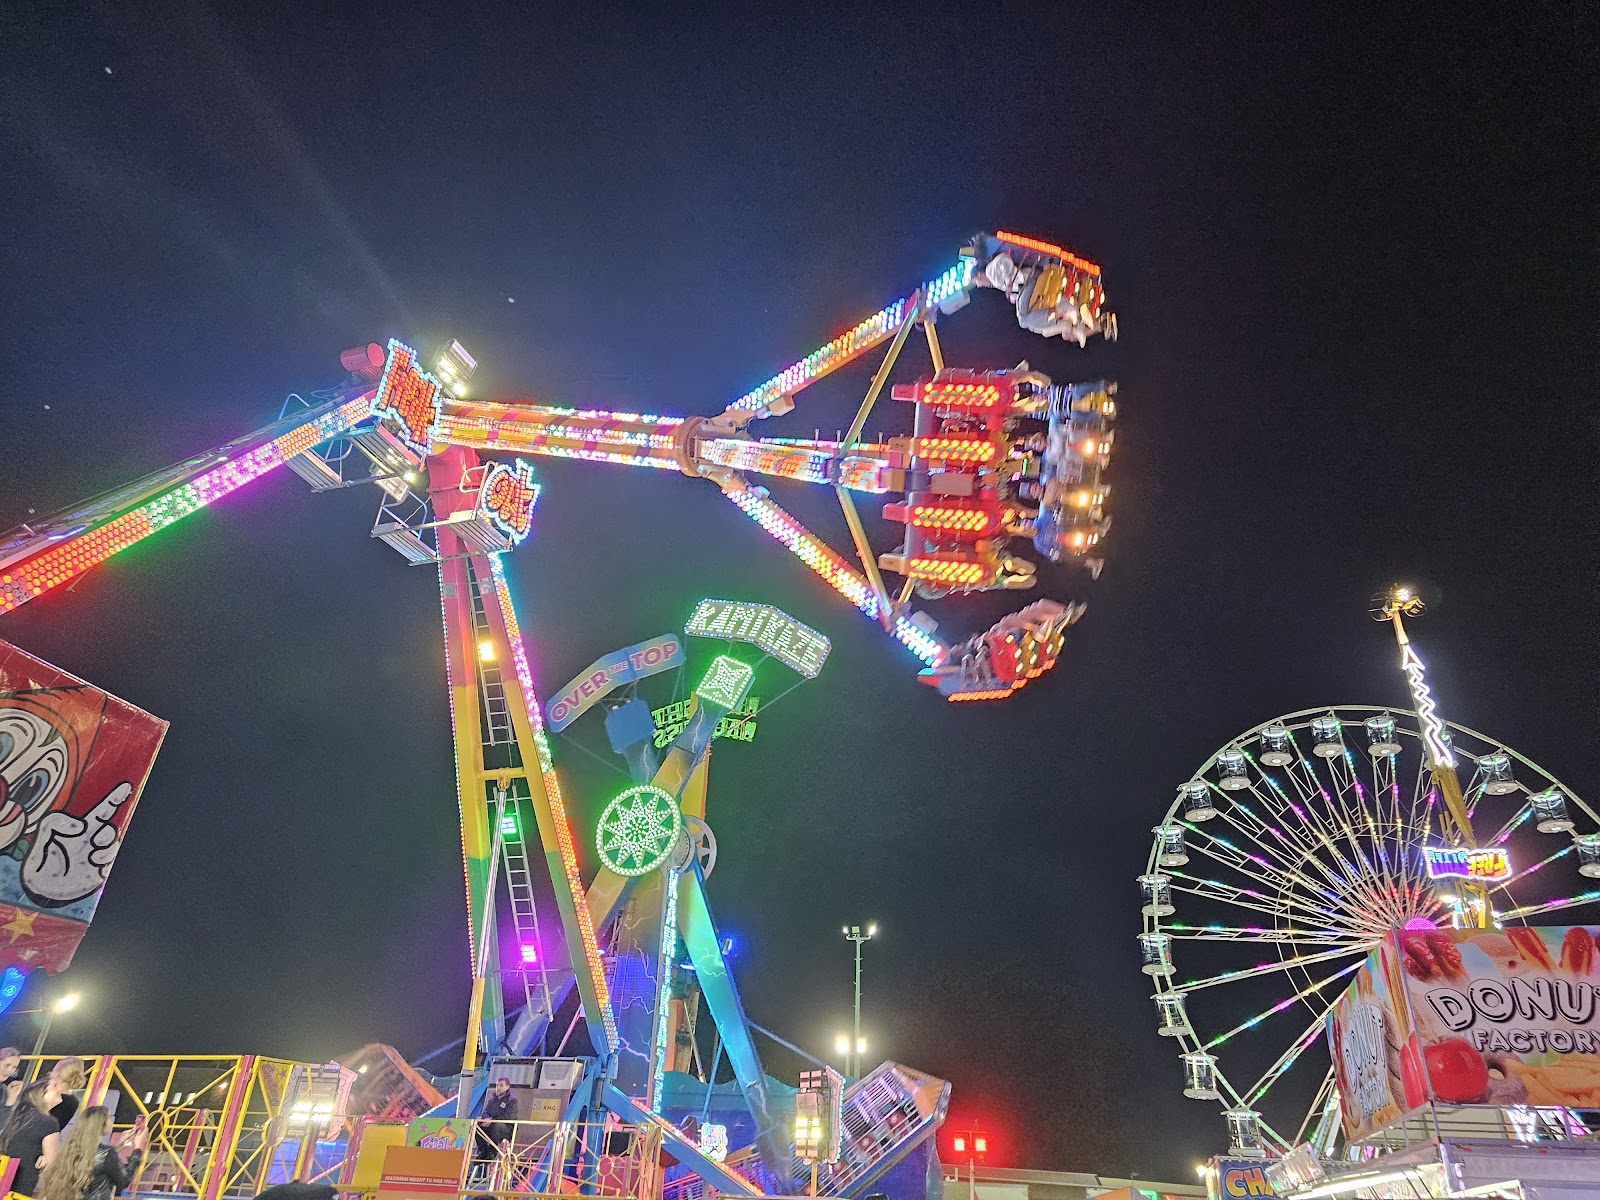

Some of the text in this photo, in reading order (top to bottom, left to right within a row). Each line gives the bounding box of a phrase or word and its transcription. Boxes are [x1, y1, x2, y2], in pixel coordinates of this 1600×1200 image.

[688, 602, 828, 673] KAMIKAZE
[549, 640, 679, 722] OVER THE TOP
[1424, 976, 1600, 1031] DONU
